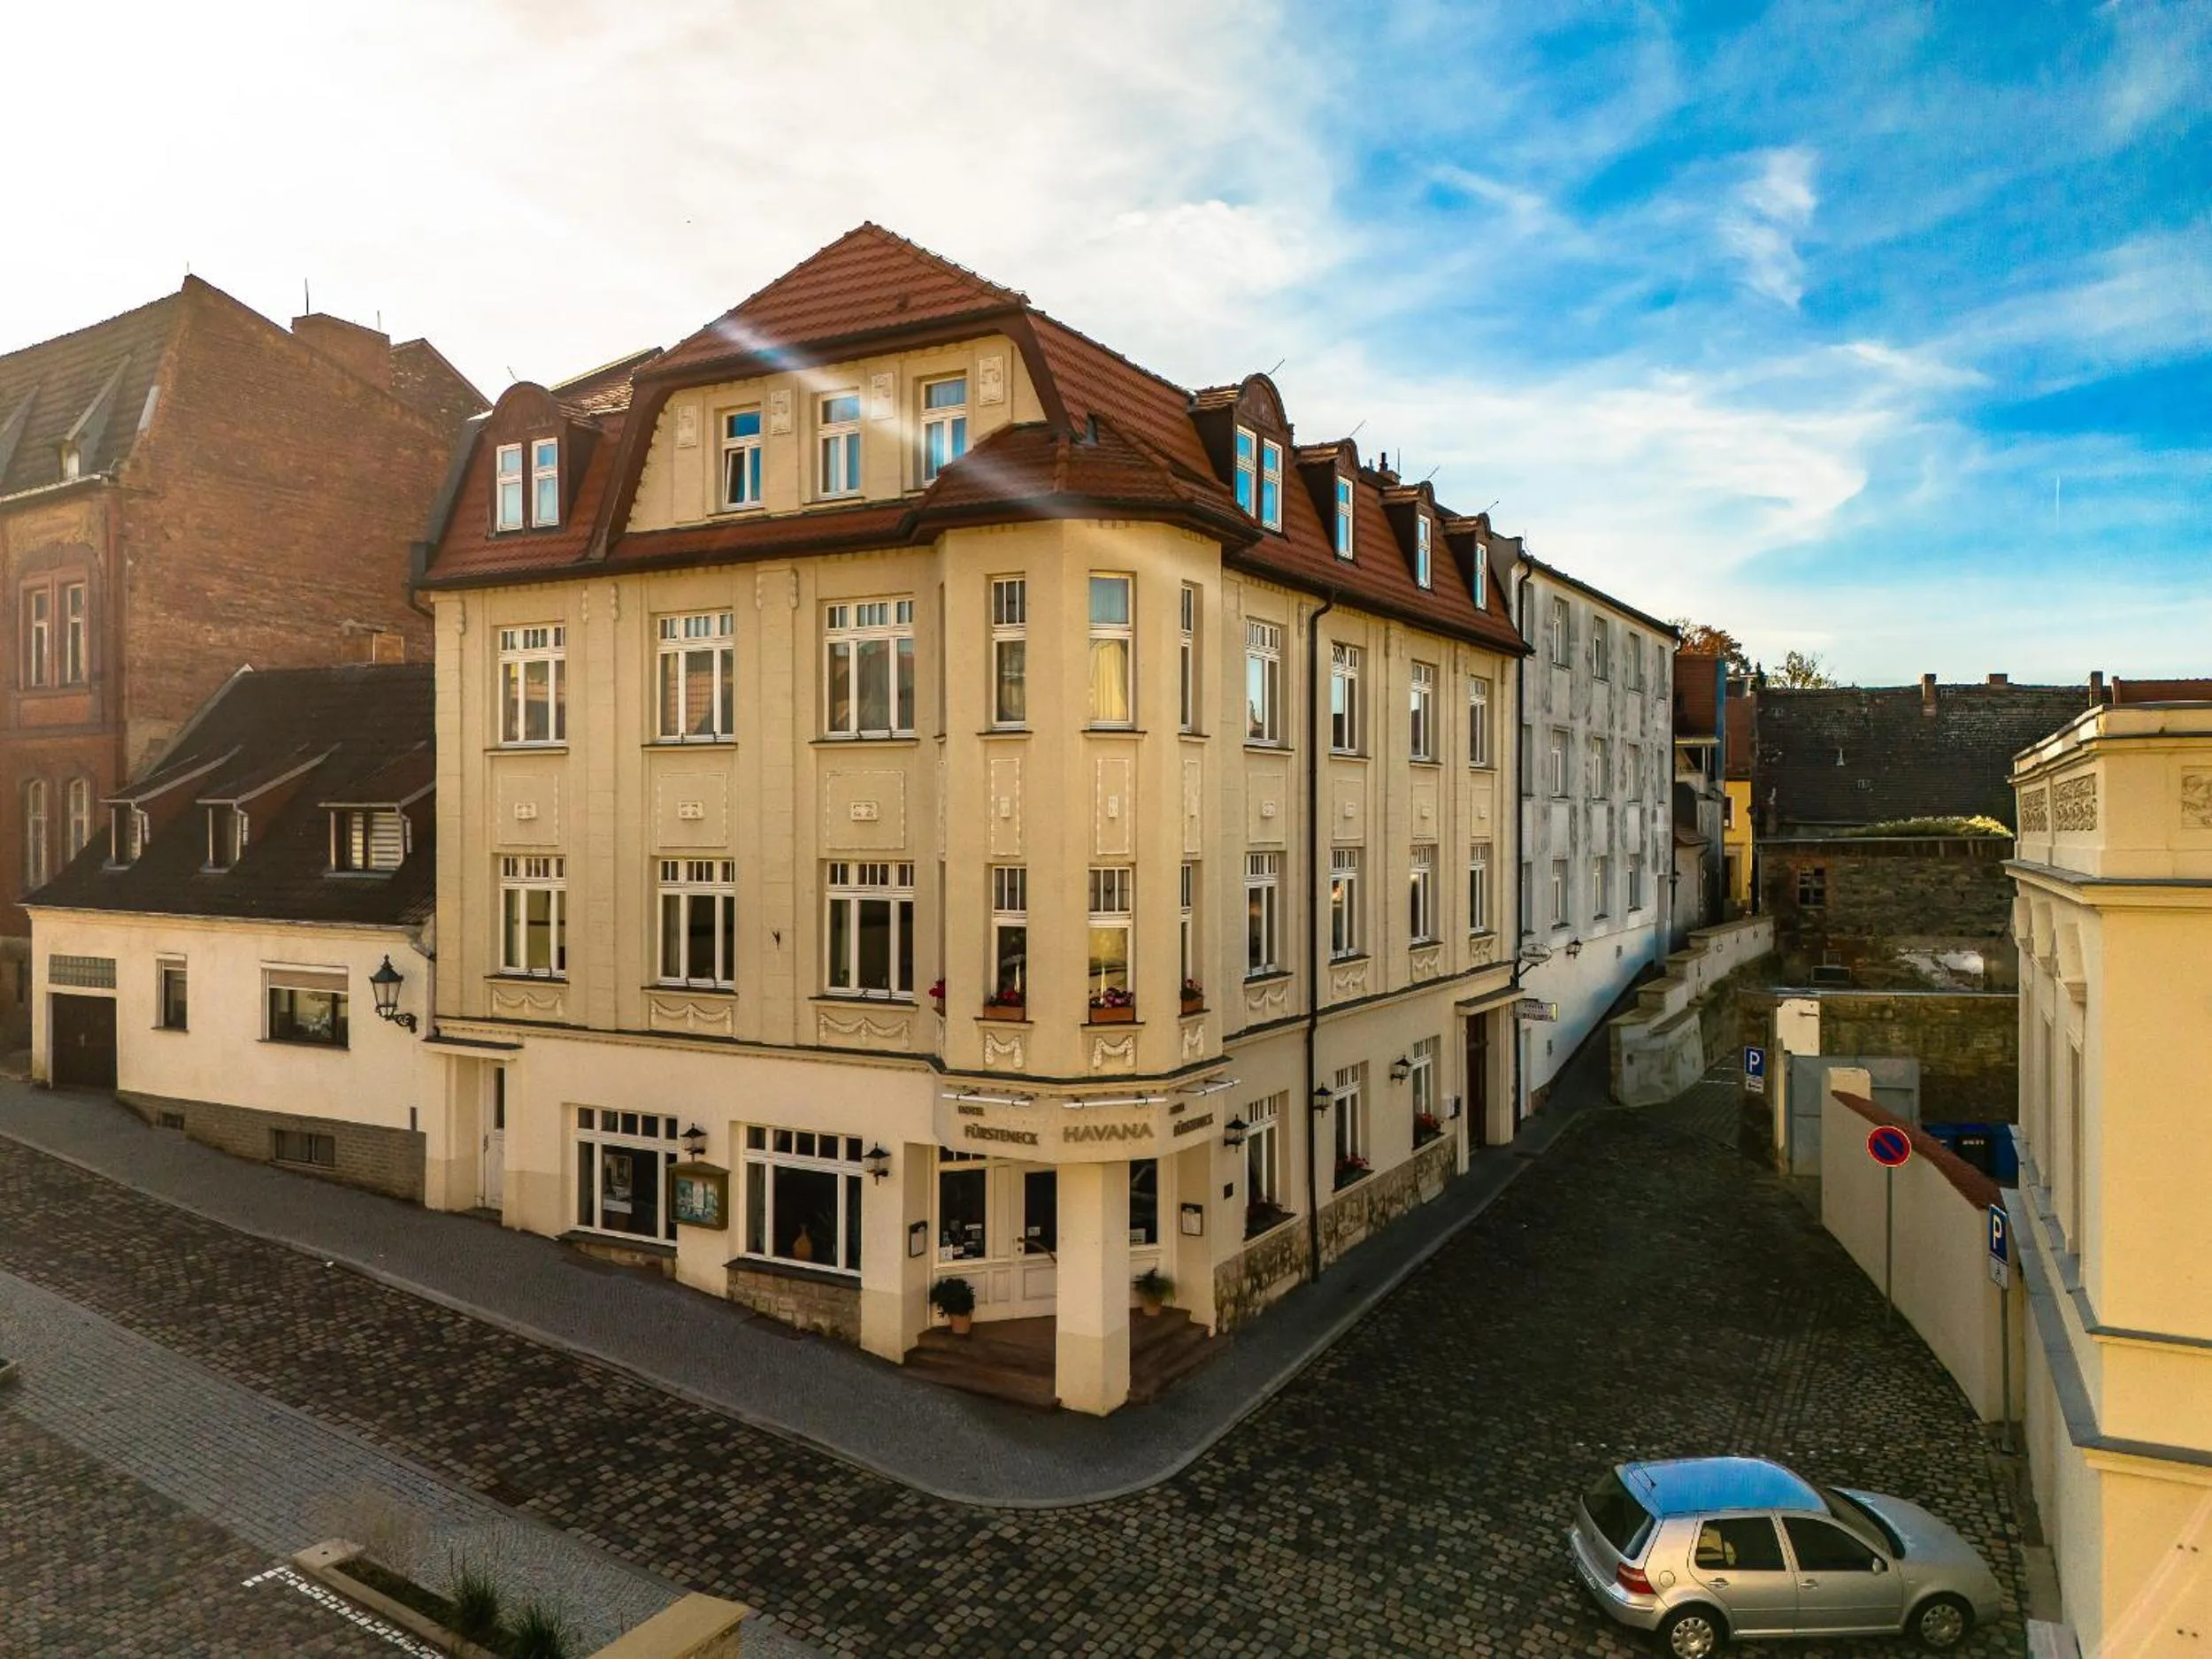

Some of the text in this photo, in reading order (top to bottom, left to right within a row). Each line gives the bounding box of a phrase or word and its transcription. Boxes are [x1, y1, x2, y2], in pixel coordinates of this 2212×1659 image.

[1749, 1051, 1760, 1072] P
[1063, 1122, 1154, 1143] HAVANA
[1993, 1214, 2002, 1249] P
